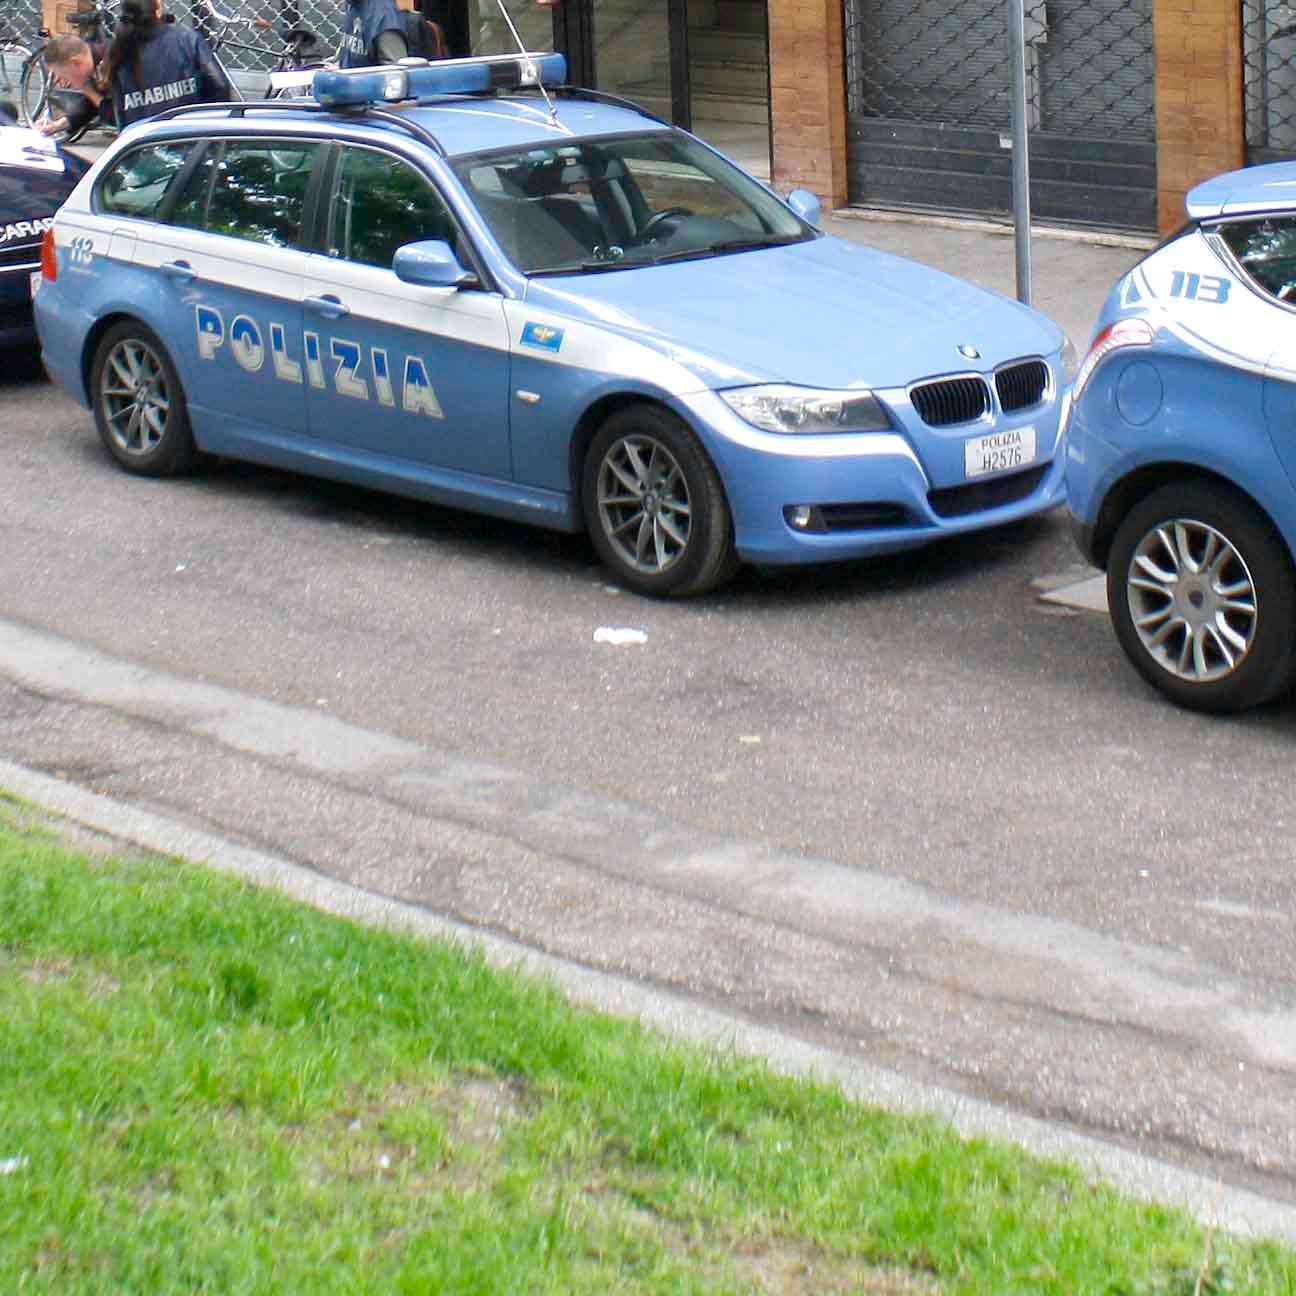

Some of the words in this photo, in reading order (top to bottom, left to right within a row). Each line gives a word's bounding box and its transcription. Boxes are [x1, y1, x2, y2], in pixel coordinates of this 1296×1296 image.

[68, 236, 94, 264] 113
[1169, 270, 1232, 304] 113
[195, 303, 445, 420] POLIZIA
[981, 431, 1022, 450] POLIZIA
